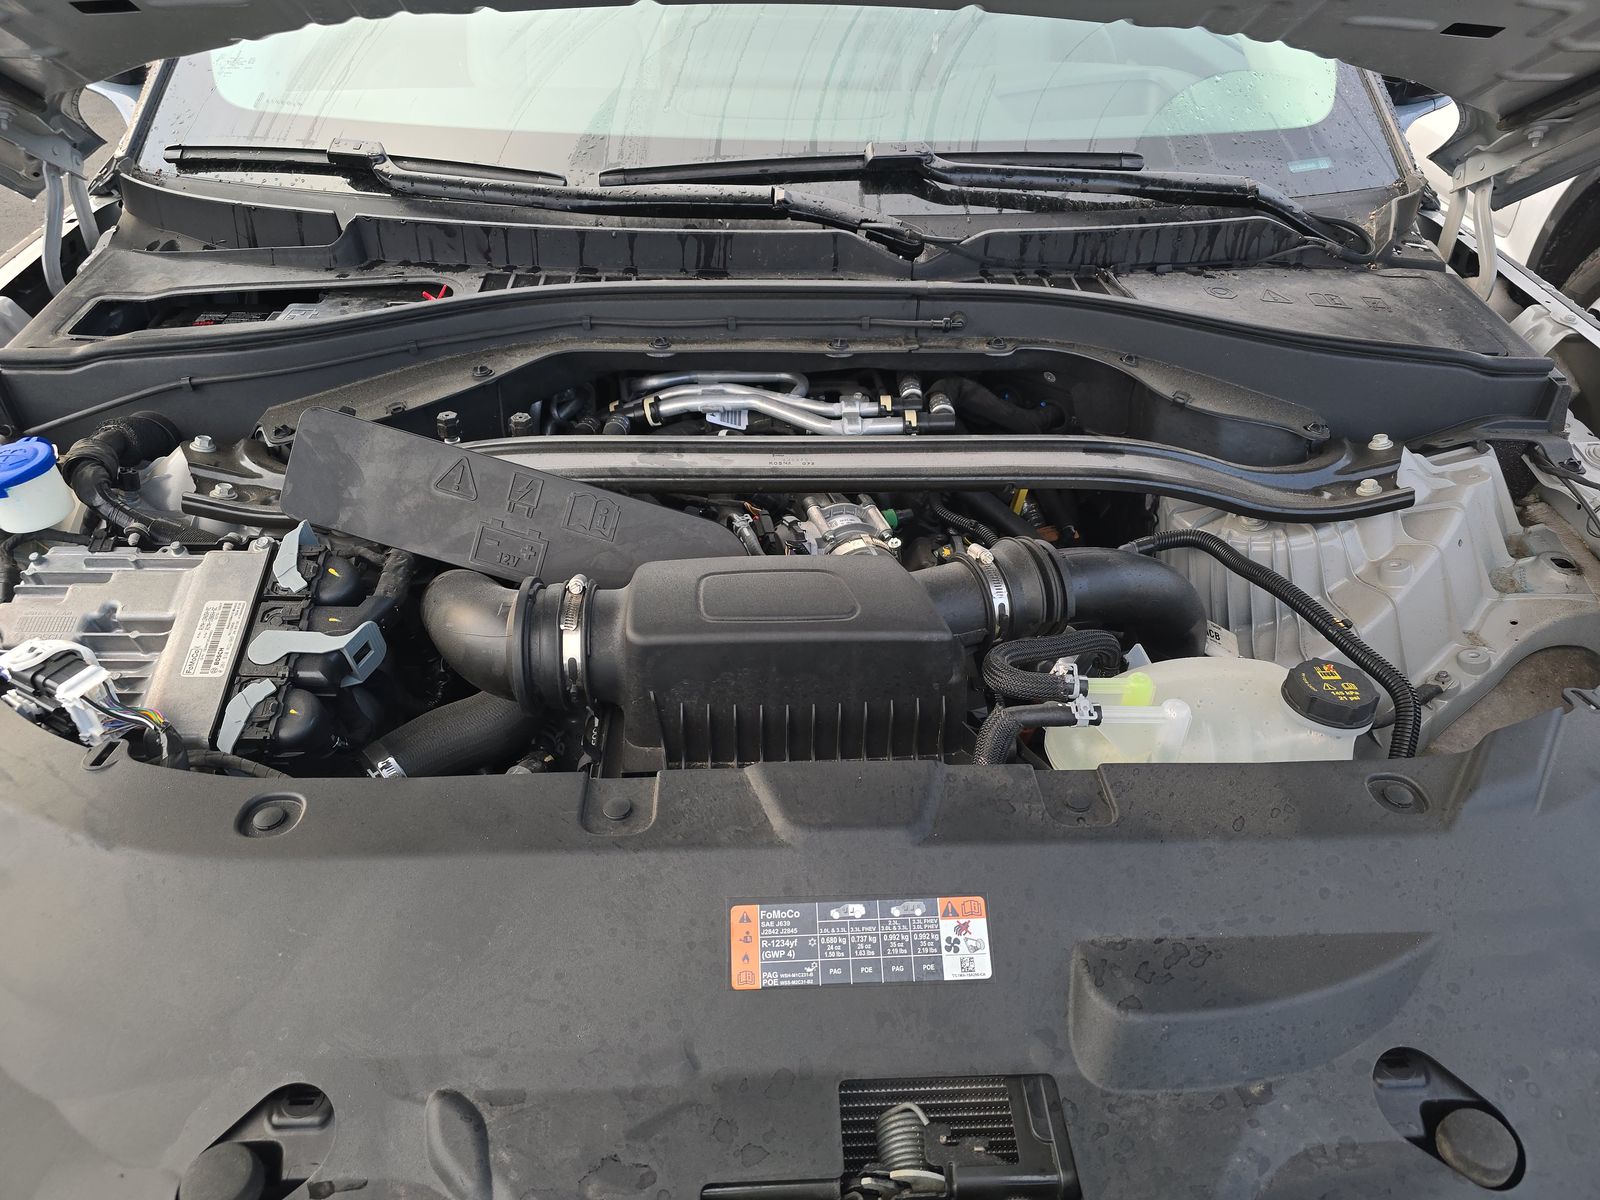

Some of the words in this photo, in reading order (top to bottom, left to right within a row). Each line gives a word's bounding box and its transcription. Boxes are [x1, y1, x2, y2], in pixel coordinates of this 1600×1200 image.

[498, 552, 521, 568] 12V
[185, 649, 200, 674] FoMoCo
[214, 647, 225, 666] BOSCH
[760, 909, 801, 920] FoMoCo
[838, 936, 847, 945] kg
[868, 935, 877, 944] kg
[901, 934, 909, 942] kg
[931, 932, 939, 941] kg
[761, 938, 798, 949] R-1234yf
[762, 950, 785, 960] (GWP
[787, 949, 796, 960] 4)
[762, 971, 778, 980] PAG
[762, 979, 779, 987] POE
